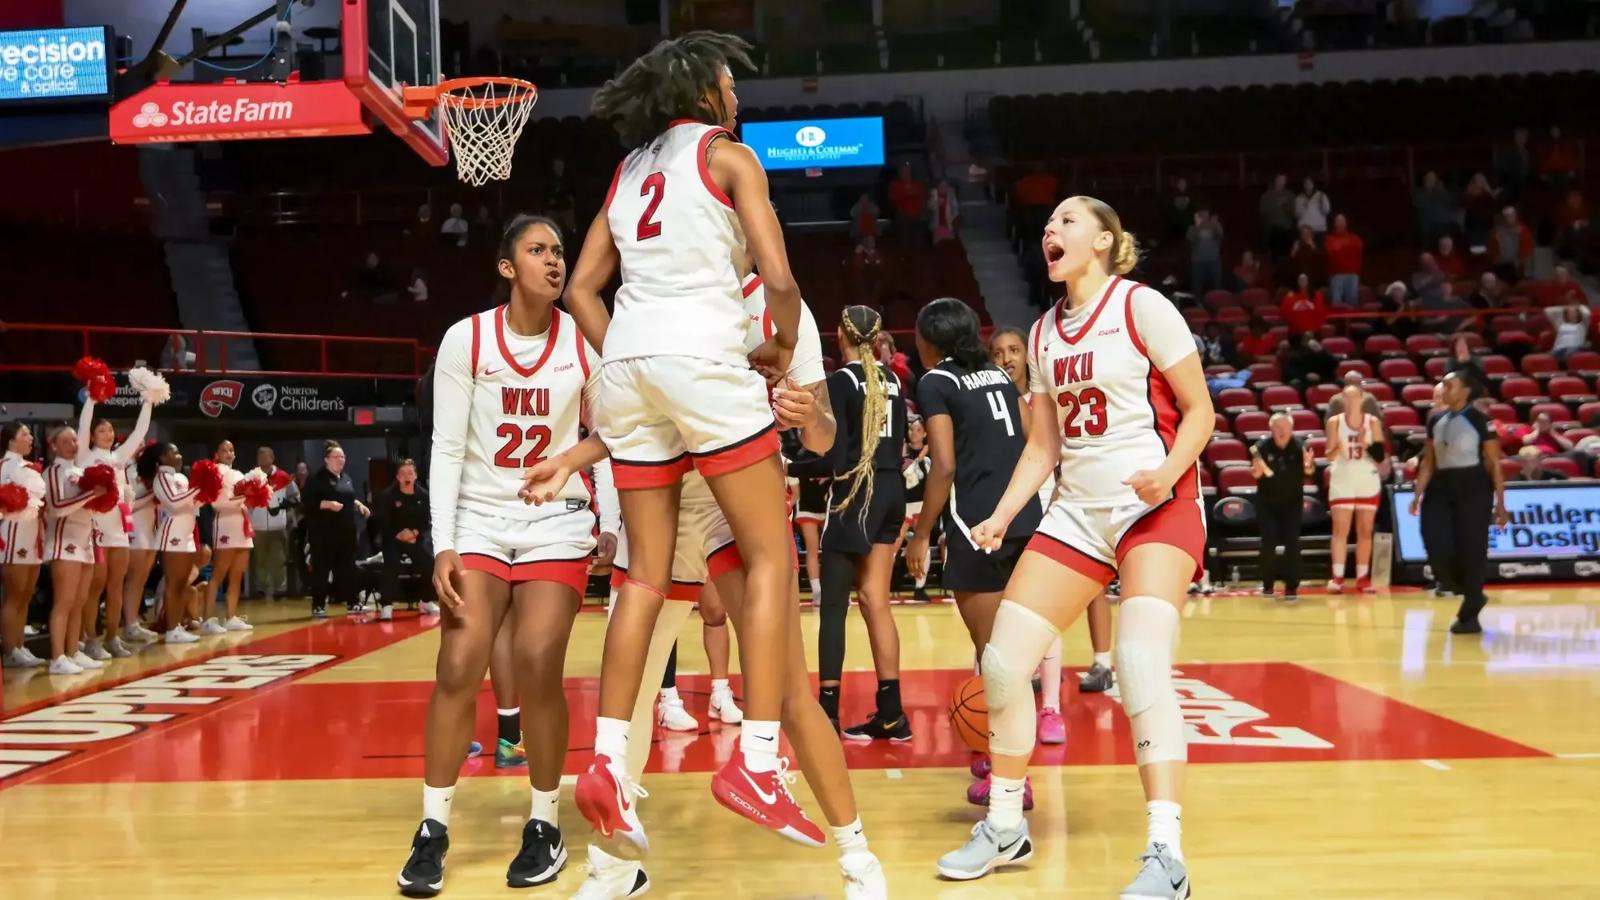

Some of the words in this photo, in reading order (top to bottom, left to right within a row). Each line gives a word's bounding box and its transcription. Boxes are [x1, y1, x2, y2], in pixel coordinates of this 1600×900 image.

[0, 35, 104, 65] ecision
[25, 63, 74, 80] care
[816, 144, 859, 155] COLEMAN
[637, 171, 666, 241] 2
[1053, 351, 1094, 387] WKU
[212, 386, 233, 398] WKU
[280, 396, 345, 411] Children's
[501, 386, 550, 417] WKU
[986, 390, 1015, 437] 4
[1057, 387, 1108, 438] 23
[494, 422, 552, 468] 22
[1348, 446, 1363, 460] 13
[1508, 503, 1600, 525] uilder
[1511, 526, 1600, 553] Desig
